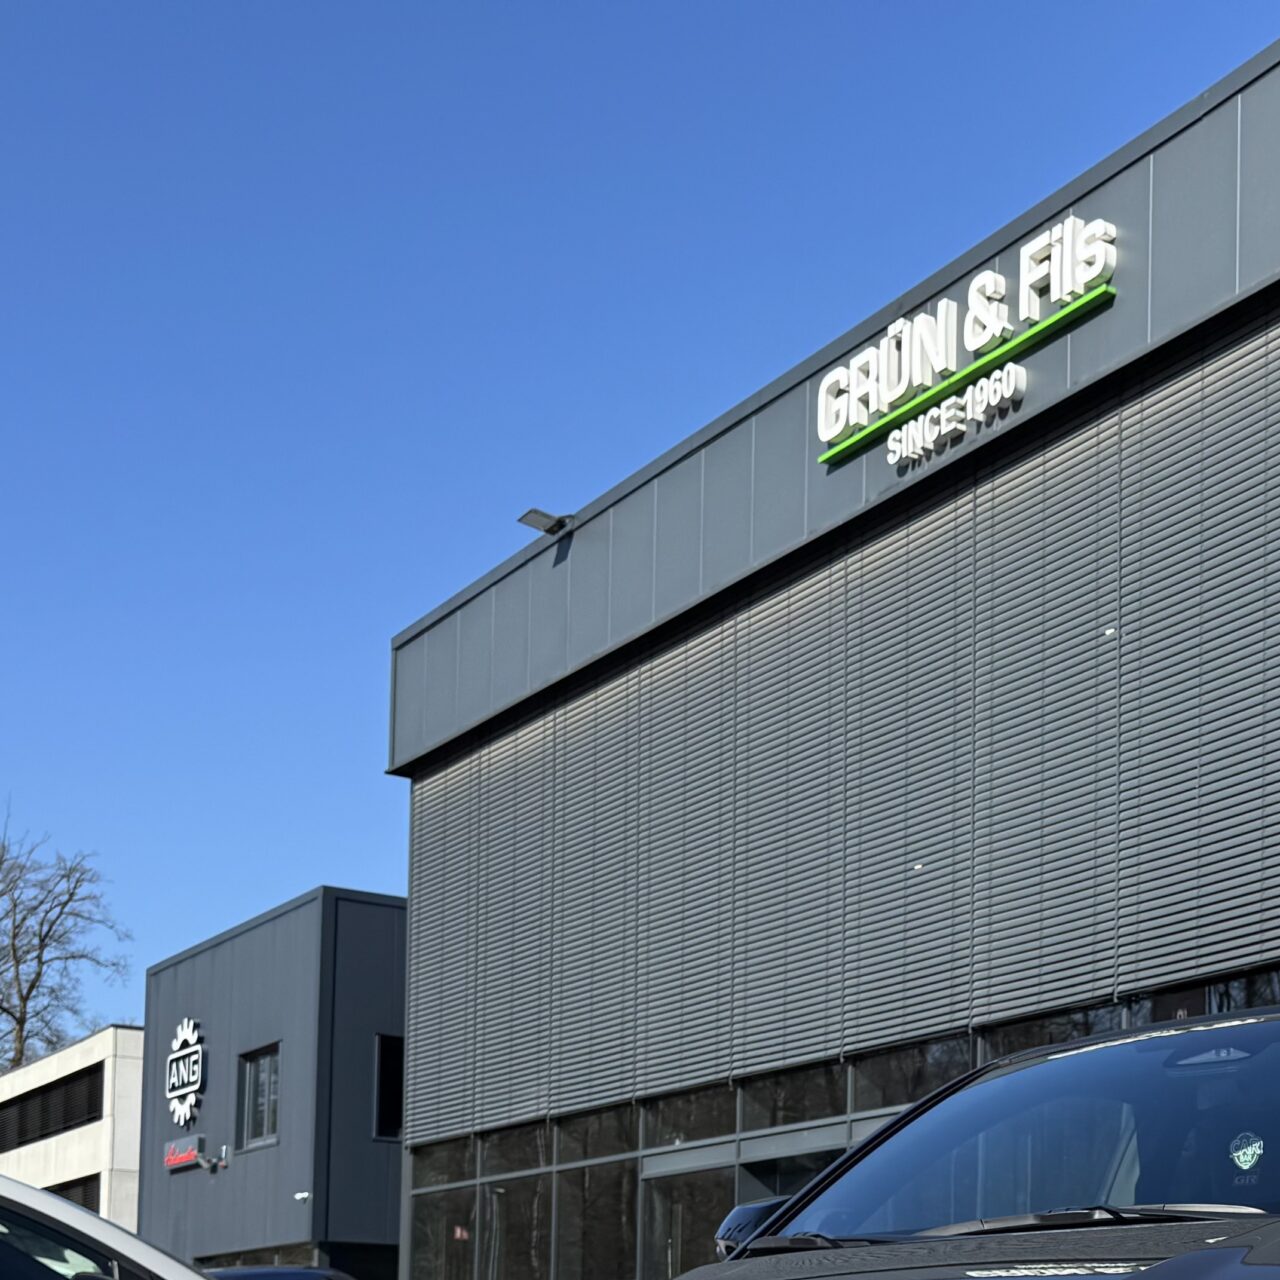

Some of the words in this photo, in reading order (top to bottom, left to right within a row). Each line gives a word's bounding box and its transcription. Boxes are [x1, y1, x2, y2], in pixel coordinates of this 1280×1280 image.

[817, 298, 957, 444] GRÜN
[963, 269, 1014, 352] &
[1018, 215, 1117, 325] Fils
[887, 395, 967, 465] SINCE
[962, 361, 1027, 421] 1960
[169, 1052, 199, 1089] ANG
